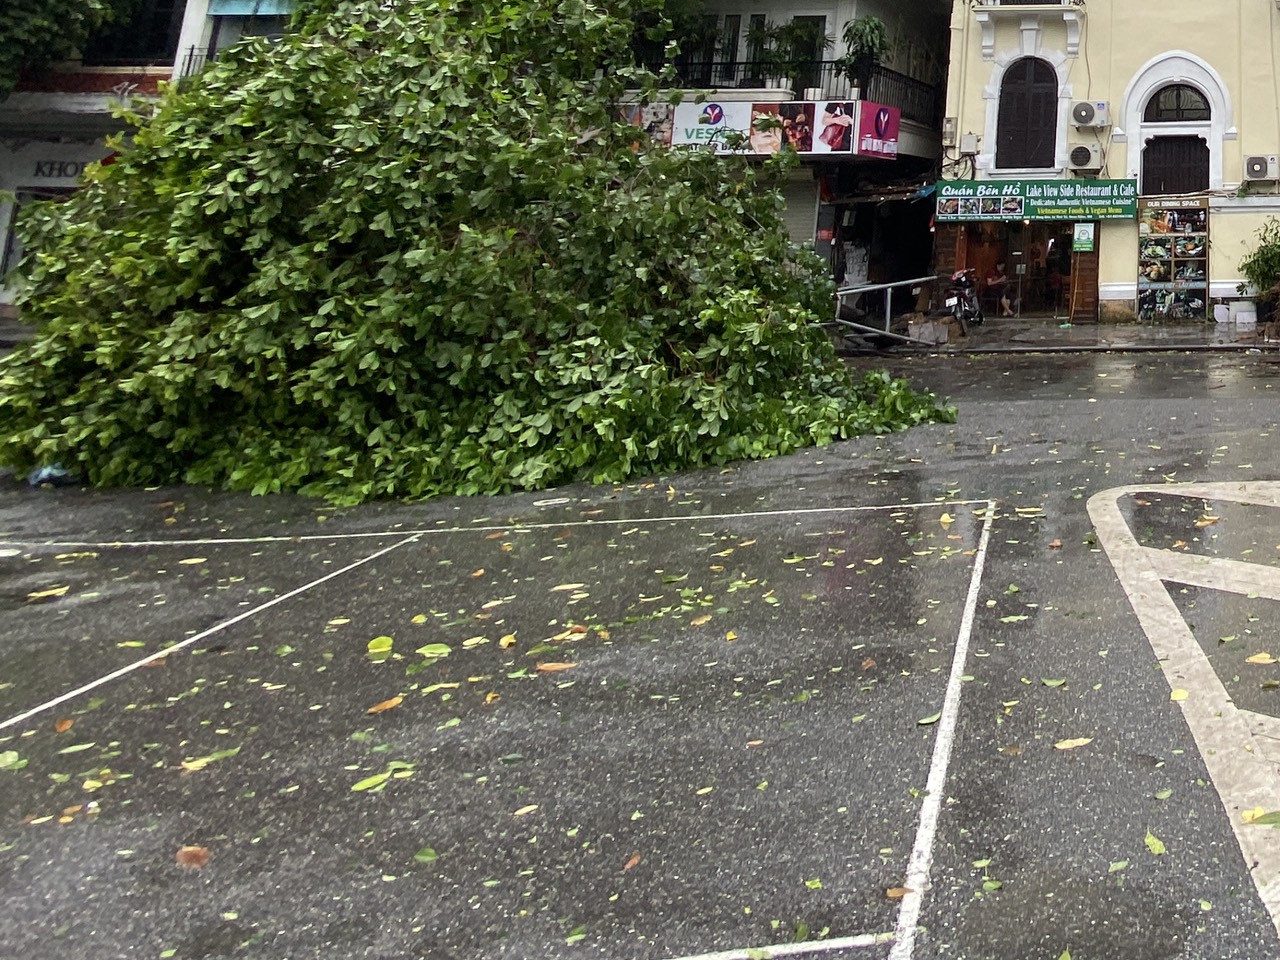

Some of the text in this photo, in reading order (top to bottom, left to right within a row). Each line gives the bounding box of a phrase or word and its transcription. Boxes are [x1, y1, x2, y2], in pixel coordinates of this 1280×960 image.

[941, 184, 974, 196] Quán
[1002, 182, 1021, 195] Hồ
[1026, 183, 1135, 197] Lake View Side Restaurant & Cafe
[1056, 198, 1081, 206] Authentic
[1081, 198, 1111, 206] Vietnamese
[1090, 207, 1107, 215] Vegan
